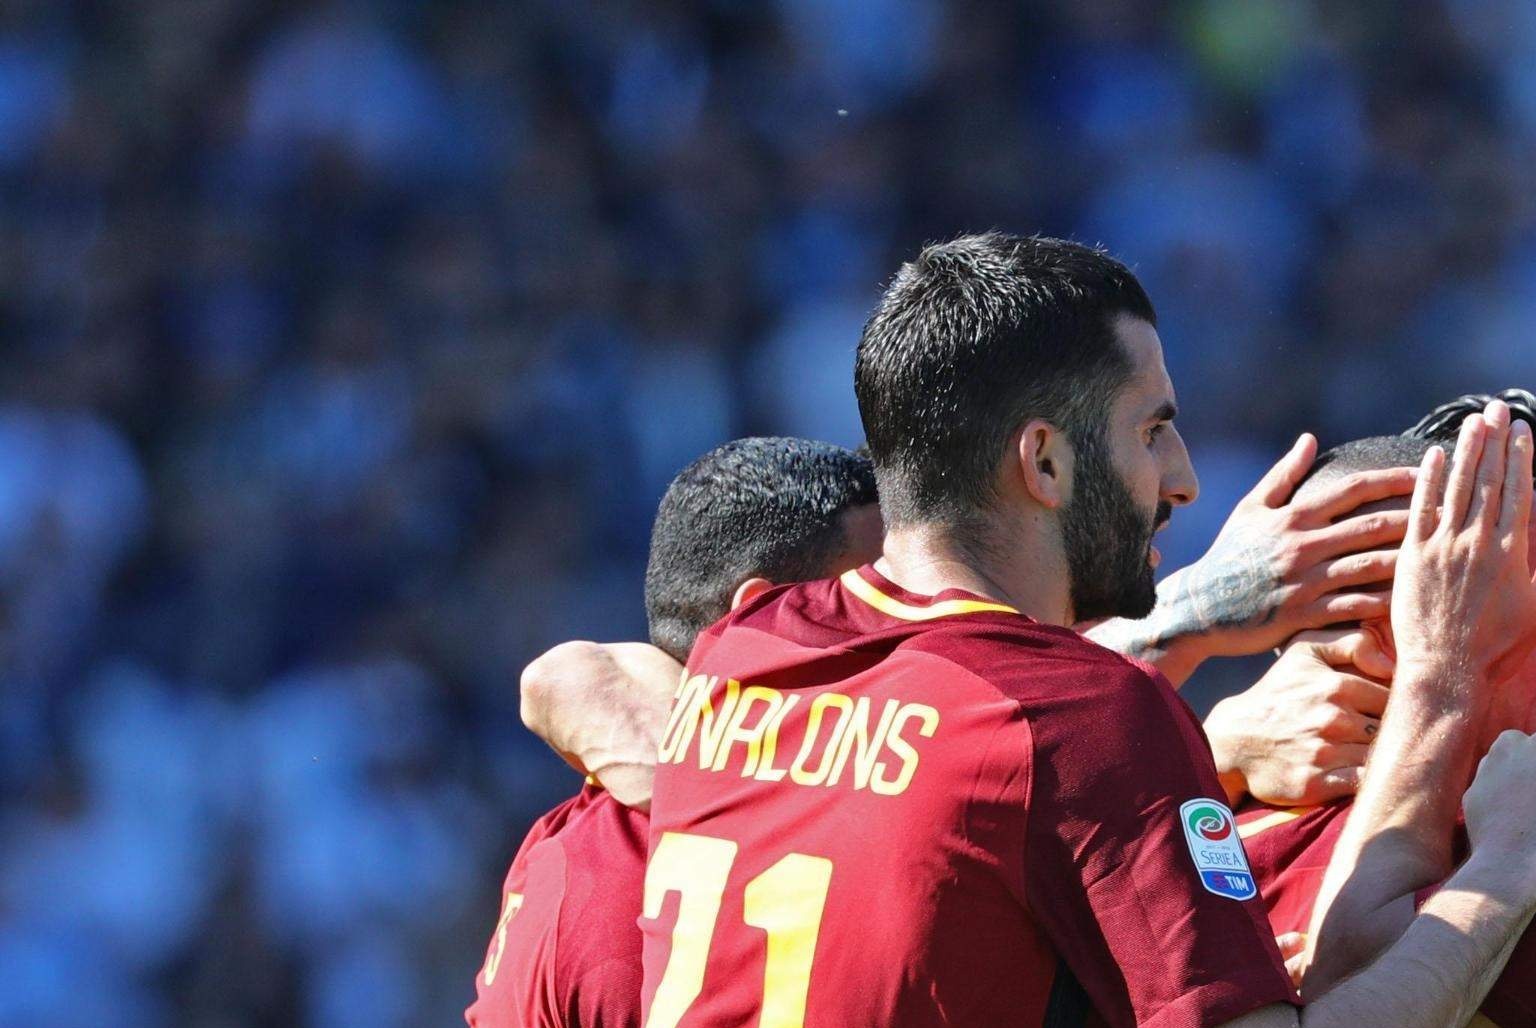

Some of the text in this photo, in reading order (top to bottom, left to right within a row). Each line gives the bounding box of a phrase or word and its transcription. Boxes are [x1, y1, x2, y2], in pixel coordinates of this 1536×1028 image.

[658, 668, 940, 796] ONALONS
[1201, 851, 1242, 867] SERIE A
[1224, 876, 1249, 892] TIM
